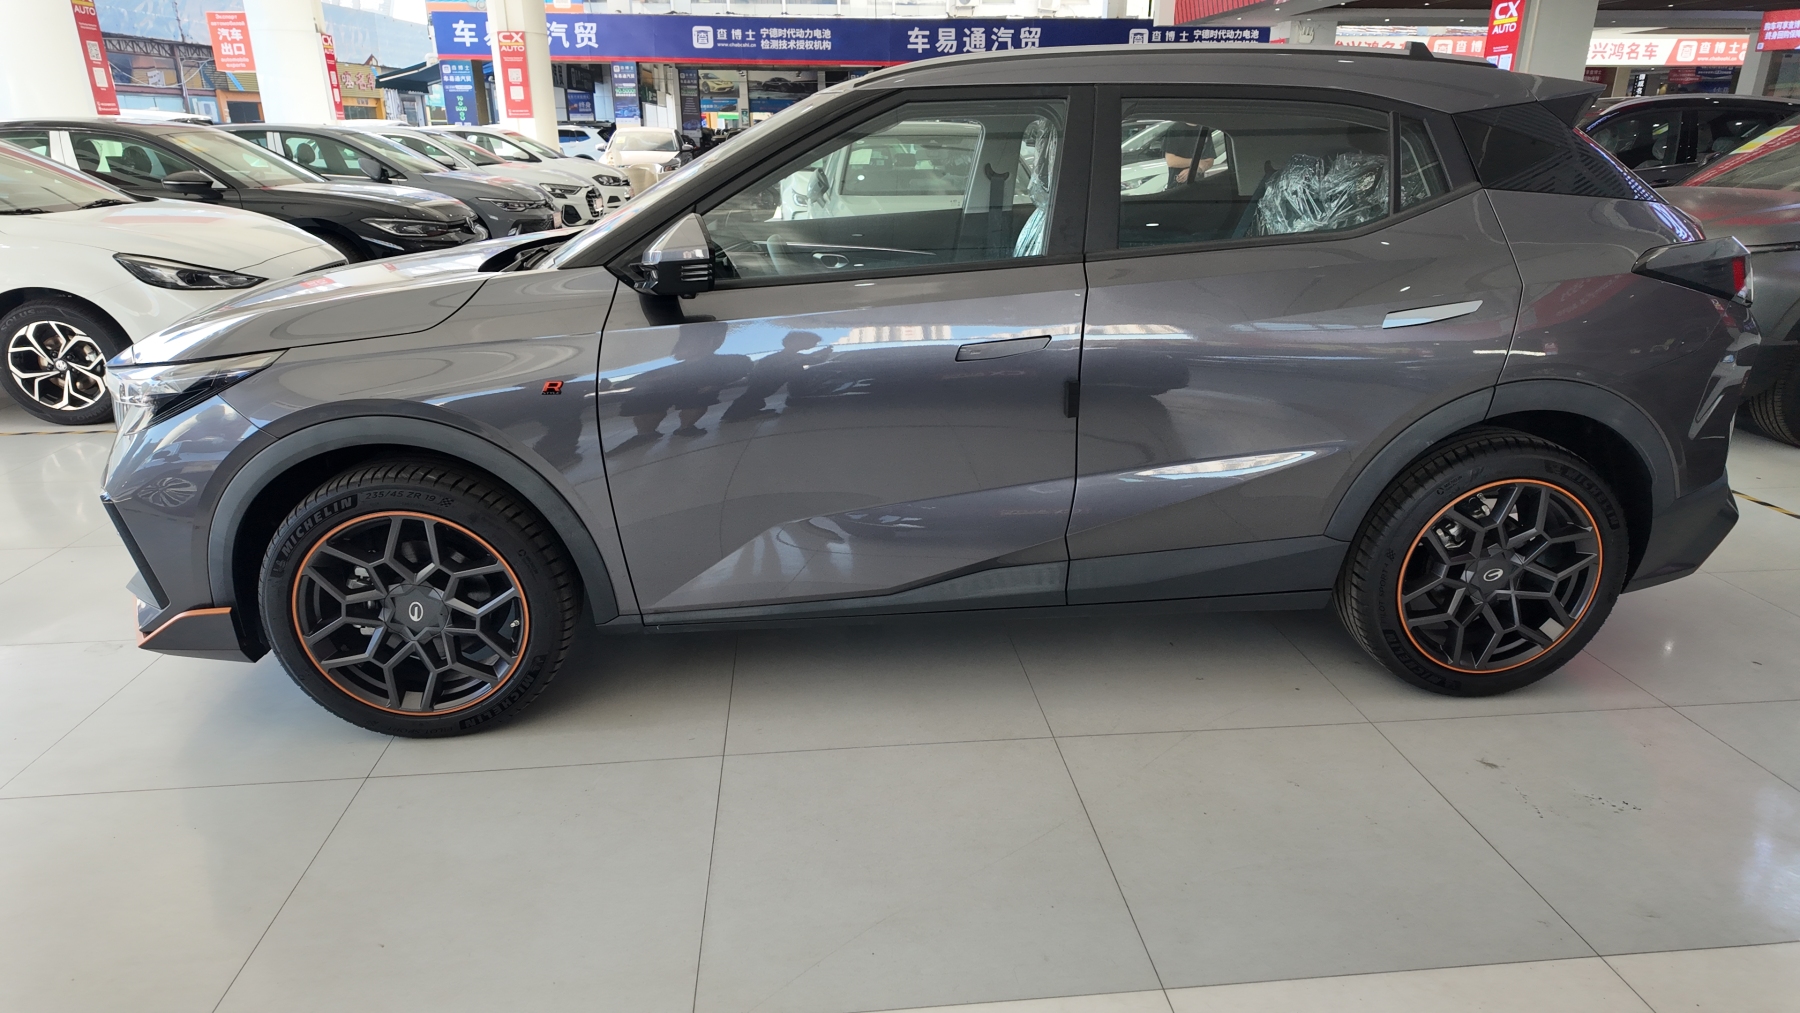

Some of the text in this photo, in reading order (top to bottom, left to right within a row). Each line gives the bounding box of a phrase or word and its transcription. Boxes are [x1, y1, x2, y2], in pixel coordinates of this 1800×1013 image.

[74, 5, 96, 16] AUTO
[1494, 0, 1520, 20] CX
[217, 28, 243, 41] 汽车
[717, 28, 756, 41] 查博士
[760, 27, 832, 39] 宁德时代动力电池
[1193, 29, 1259, 40] 宁德时代动力电池
[1492, 22, 1517, 35] AUTO
[499, 32, 523, 43] CX
[907, 26, 1042, 53] 车易通汽贸
[1151, 30, 1189, 42] 查博士
[221, 42, 246, 55] 出口
[760, 39, 832, 50] 检测技术授权机构
[1588, 42, 1659, 60] 兴鸿名车
[1, 309, 36, 331] SOLUS
[542, 381, 564, 392] R
[365, 490, 404, 500] 235/45
[406, 491, 421, 499] ZR
[1566, 468, 1620, 530] MICHELIN
[281, 496, 353, 558] MICHELIN
[464, 673, 535, 728] MICHELIN
